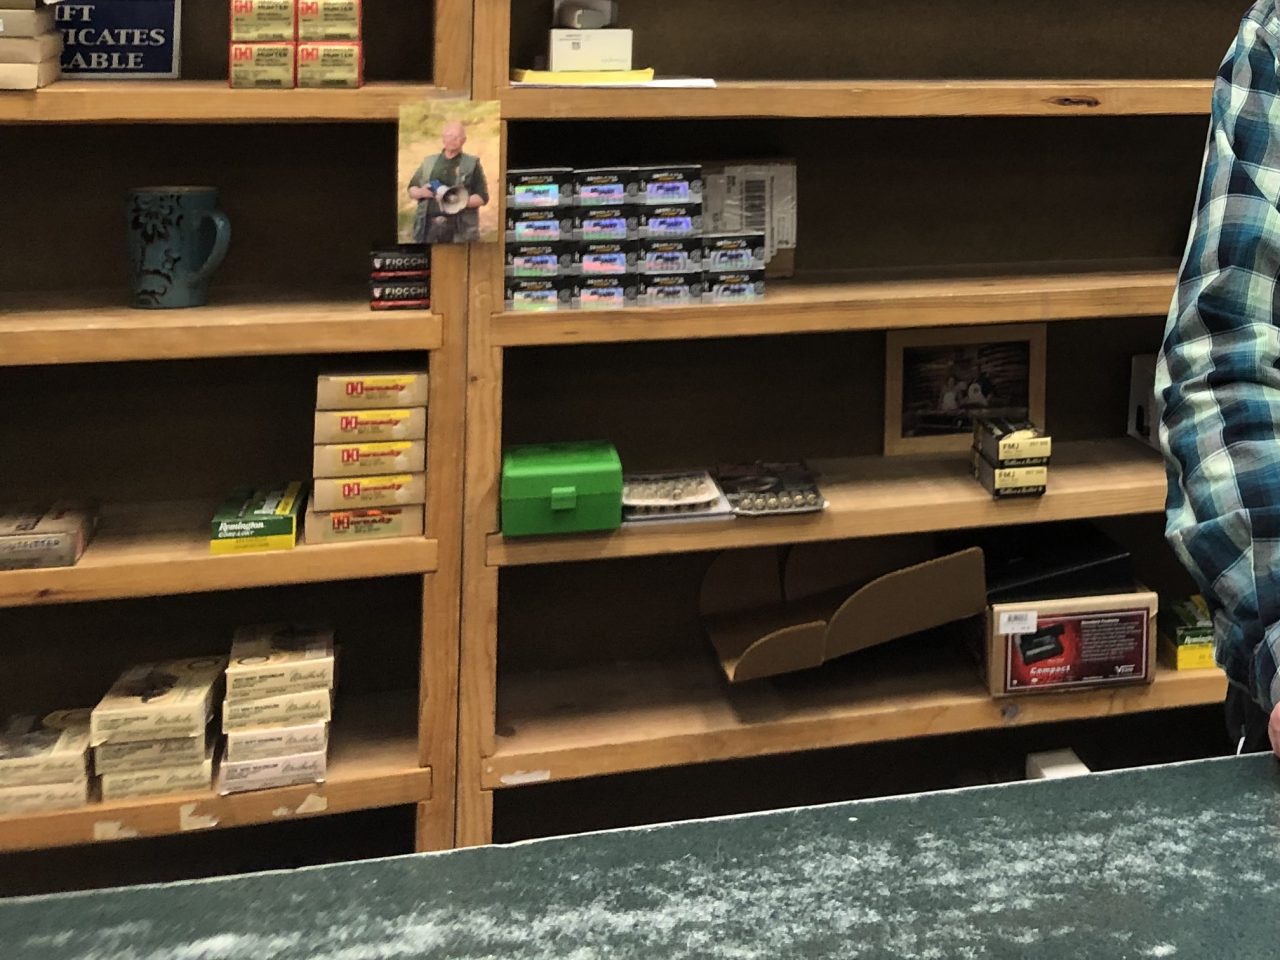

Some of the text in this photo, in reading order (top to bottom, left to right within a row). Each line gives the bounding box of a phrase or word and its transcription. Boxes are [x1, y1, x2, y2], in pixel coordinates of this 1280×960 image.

[60, 28, 166, 47] ICATES
[385, 258, 428, 266] FIOCCHI
[385, 287, 428, 295] FIOCCHI
[346, 382, 406, 396] Hornady
[341, 416, 401, 430] Hornady
[342, 448, 402, 463] Hornady
[343, 483, 402, 497] Hornady
[218, 520, 265, 532] Remington
[332, 515, 393, 530] Hornady
[1030, 664, 1071, 675] Compact
